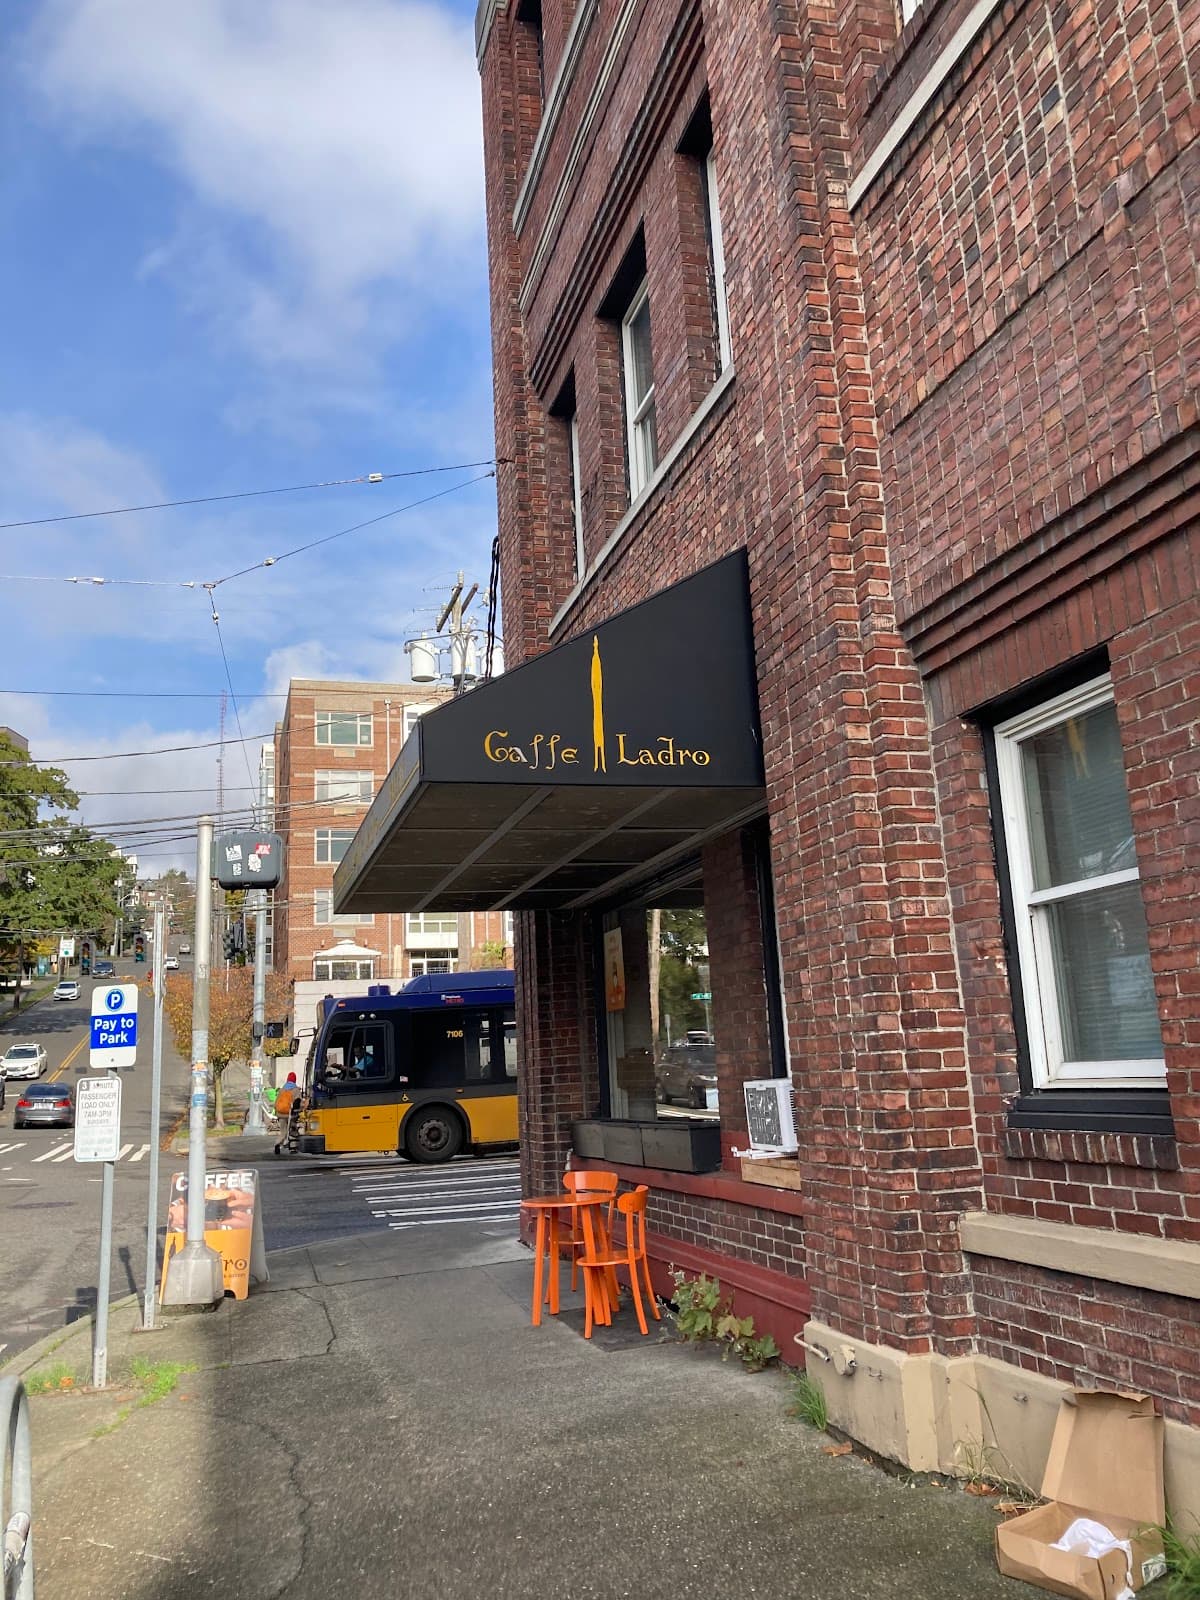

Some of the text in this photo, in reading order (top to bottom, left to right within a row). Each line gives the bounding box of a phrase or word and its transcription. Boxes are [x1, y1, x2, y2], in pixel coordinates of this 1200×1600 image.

[615, 733, 711, 766] Ladro
[94, 1016, 135, 1032] Pay to
[99, 1031, 128, 1044] Park
[446, 1030, 464, 1038] 7106
[93, 1082, 114, 1091] MNUTE
[80, 1092, 117, 1102] PASSENGER
[81, 1101, 115, 1110] LOAD ONLY
[175, 1173, 253, 1191] CFFEE
